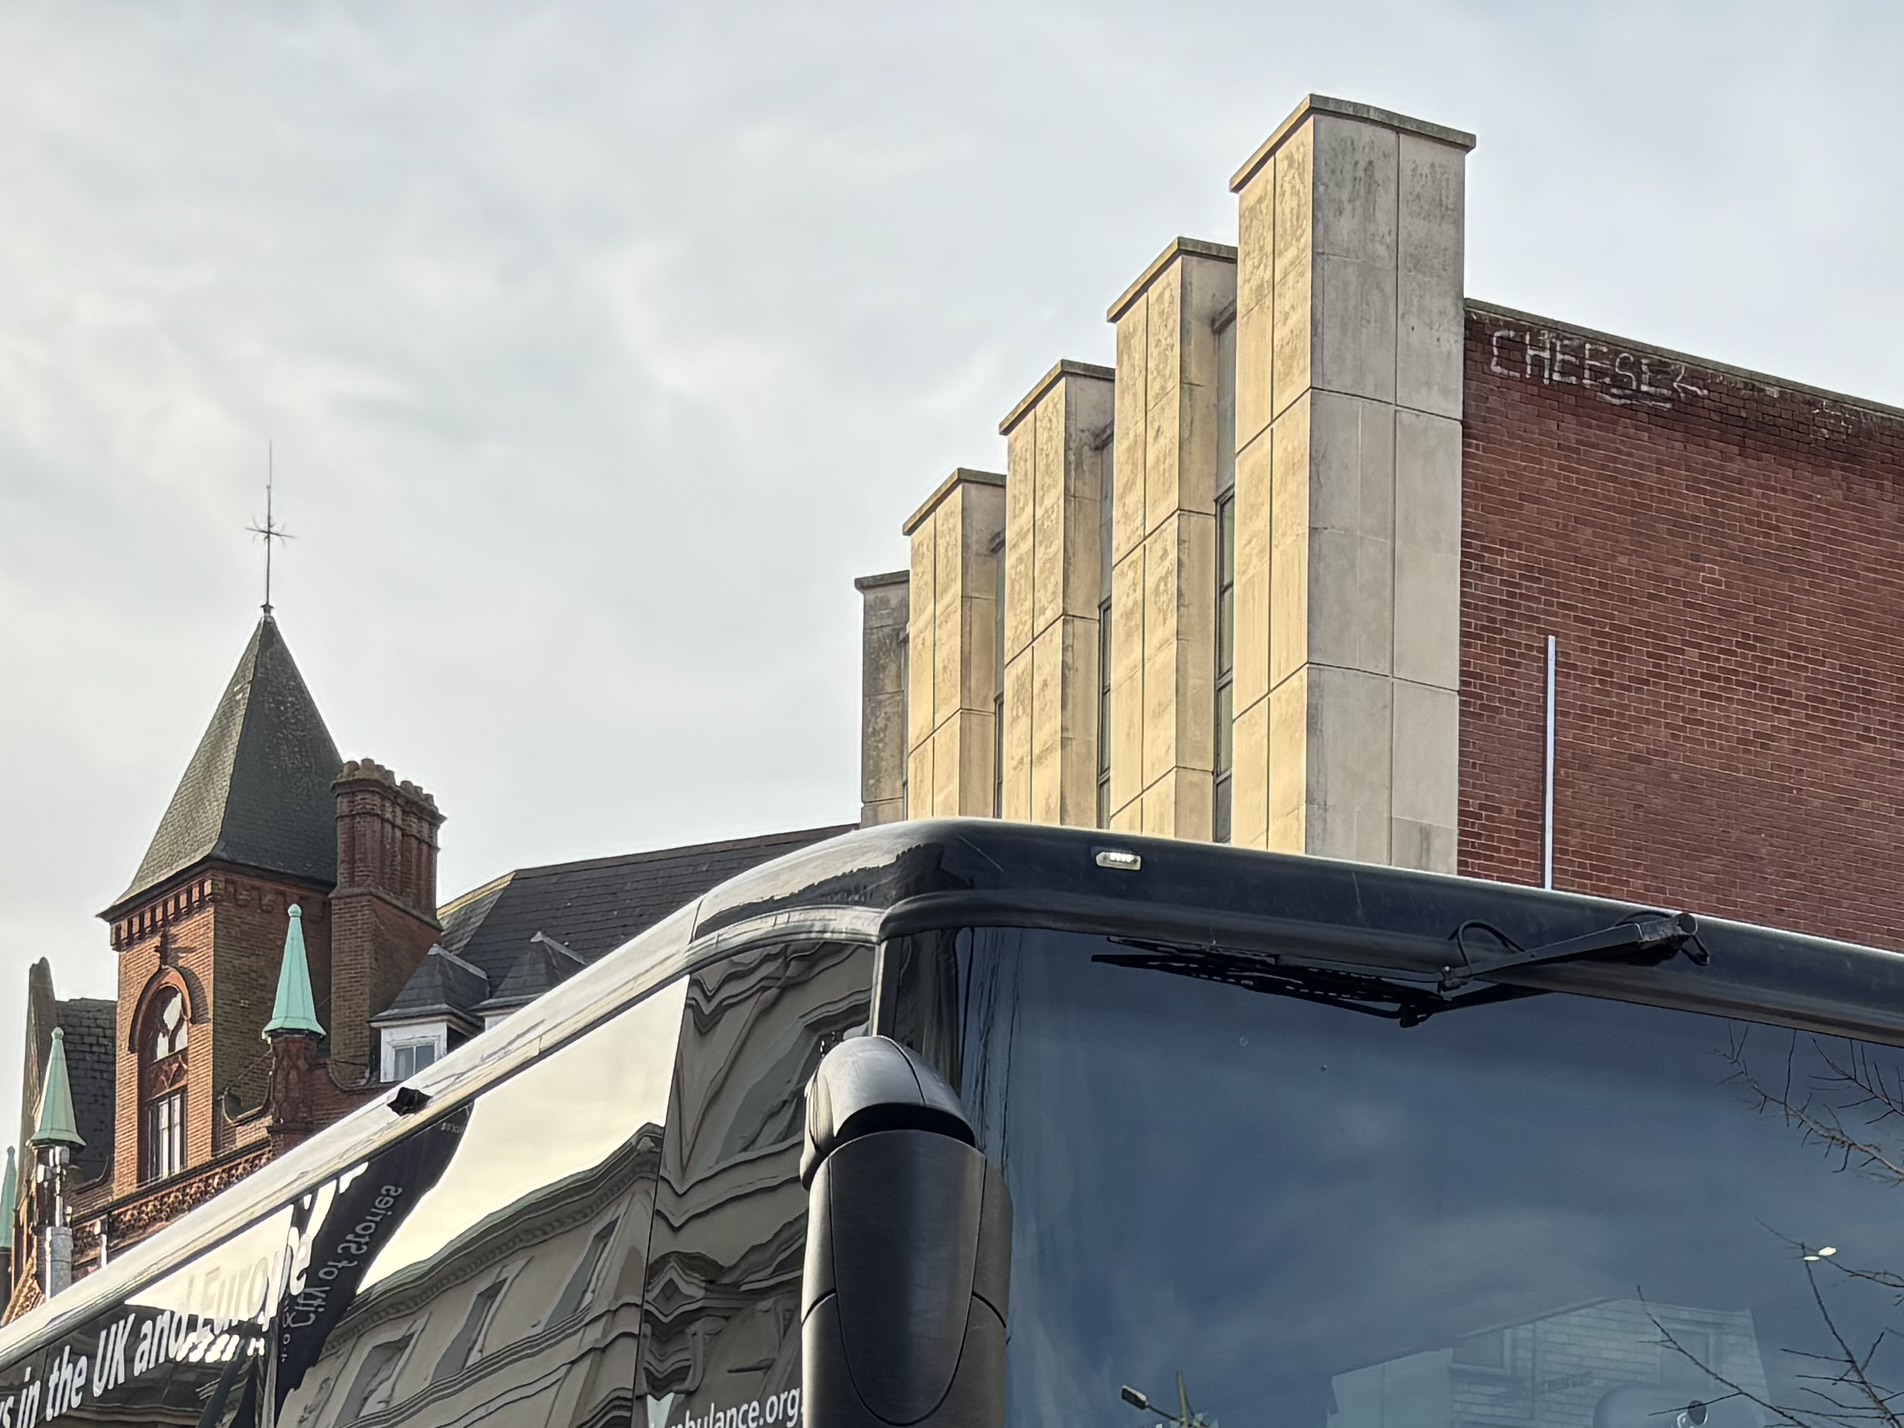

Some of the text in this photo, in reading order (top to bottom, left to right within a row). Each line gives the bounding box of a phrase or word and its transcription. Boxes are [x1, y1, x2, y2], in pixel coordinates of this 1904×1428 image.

[45, 1345, 87, 1421] the
[92, 1313, 138, 1397] UK
[133, 1274, 194, 1378] and
[193, 1231, 313, 1339] Europe
